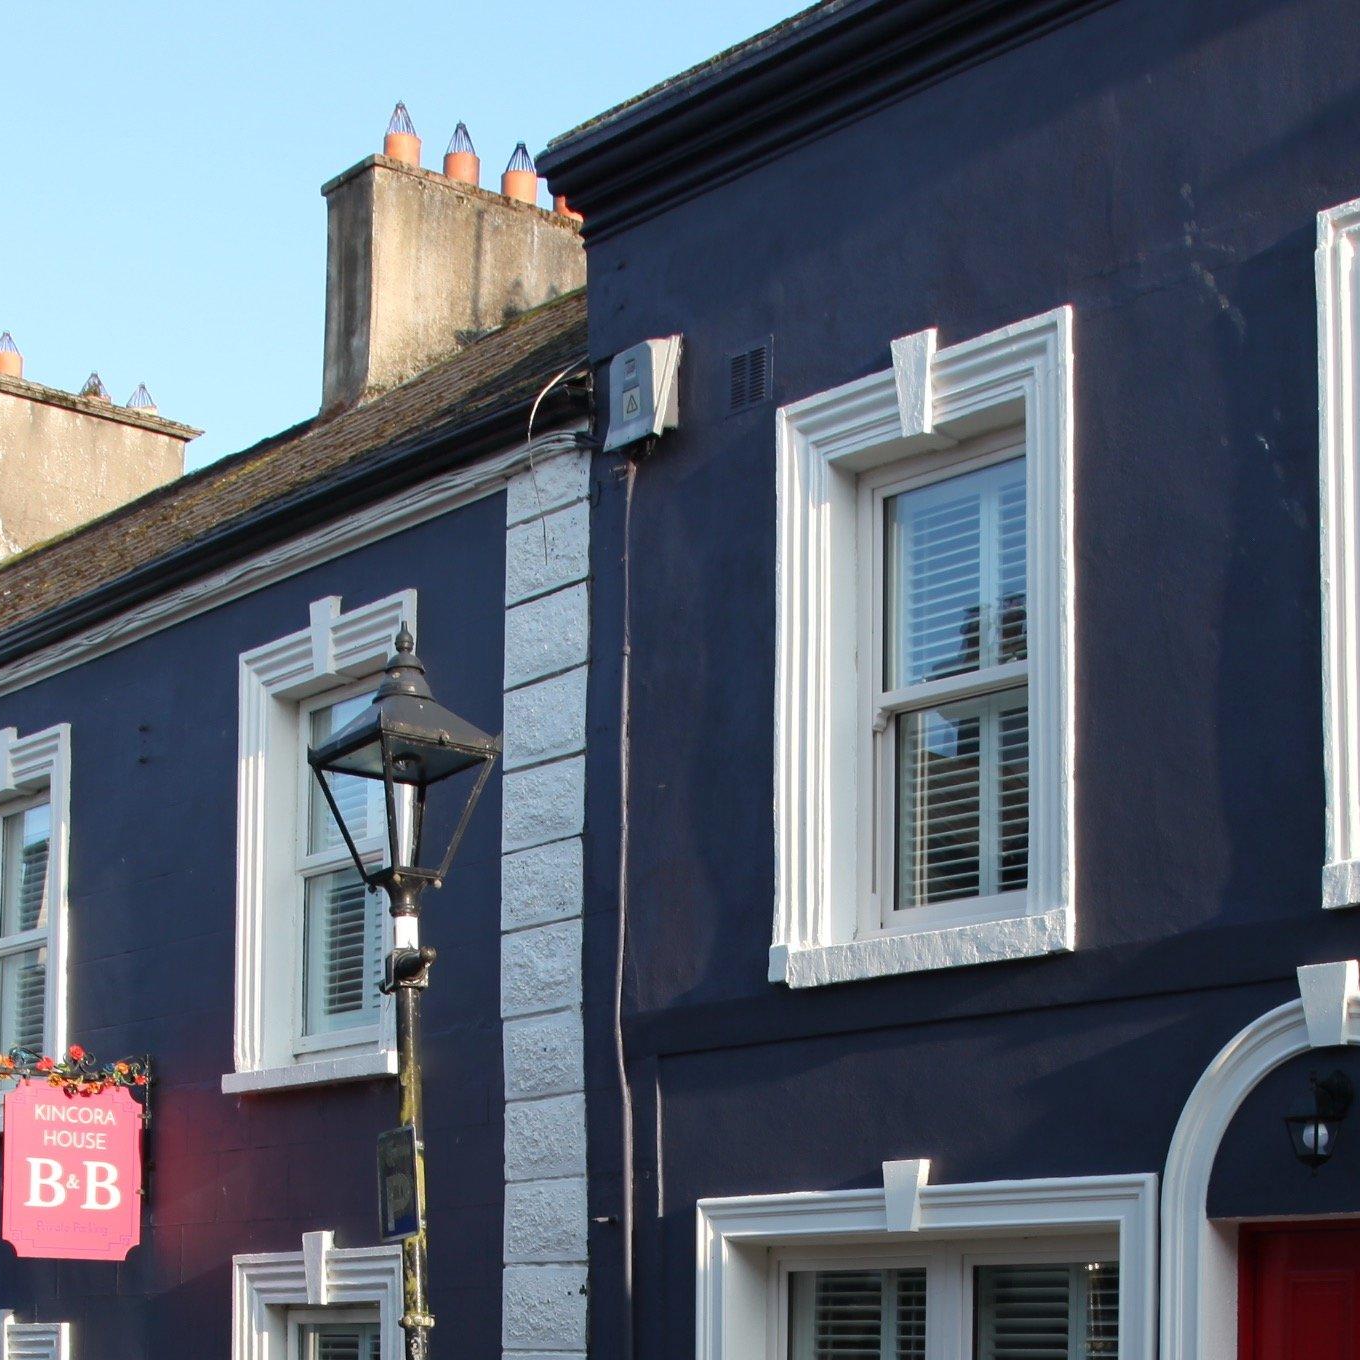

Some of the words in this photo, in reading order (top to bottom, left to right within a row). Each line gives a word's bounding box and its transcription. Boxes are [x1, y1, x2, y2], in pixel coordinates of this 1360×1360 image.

[34, 1103, 116, 1126] KINCORA
[43, 1130, 107, 1150] HOUSE
[23, 1157, 122, 1211] B&B
